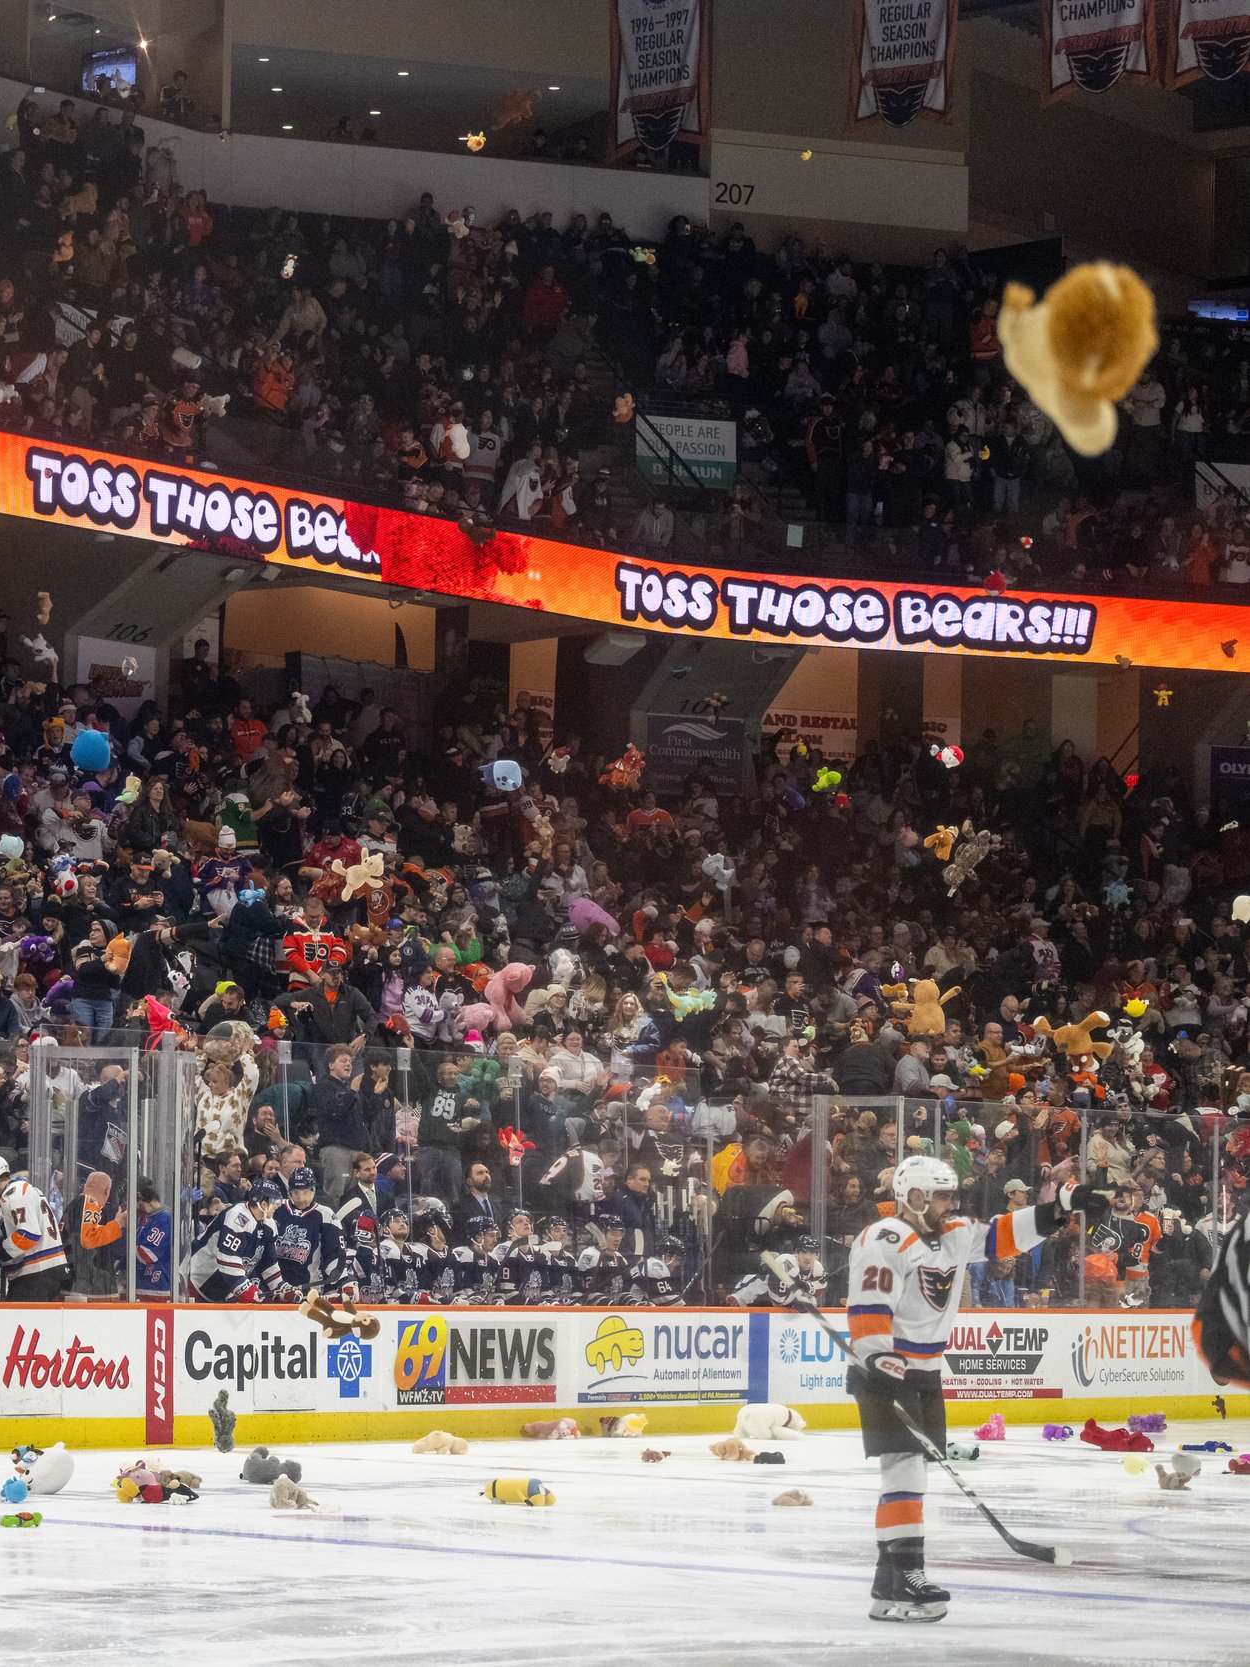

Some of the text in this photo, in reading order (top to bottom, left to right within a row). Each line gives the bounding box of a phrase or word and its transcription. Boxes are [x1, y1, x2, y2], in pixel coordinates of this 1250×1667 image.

[880, 2, 931, 24] REGULAR
[1060, 0, 1136, 22] CHAMPIONS
[635, 29, 684, 53] REGULAR
[882, 22, 926, 42] SEASON
[638, 48, 681, 70] SEASON
[871, 40, 936, 63] CHAMPIONS
[629, 65, 690, 90] CHAMPIONS
[715, 182, 755, 205] 207
[698, 427, 720, 439] ARE
[676, 442, 725, 456] PASSION
[32, 454, 136, 518] TOSS
[620, 569, 713, 621] TOSS
[106, 623, 153, 642] 106
[762, 714, 797, 728] AND
[649, 743, 741, 761] Commonwealth
[667, 736, 692, 747] First
[1219, 762, 1250, 775] OLY
[431, 1096, 456, 1119] 89
[84, 1210, 100, 1225] 25
[147, 1227, 165, 1247] 31
[221, 1232, 242, 1252] 58
[657, 1281, 673, 1294] 64
[861, 1265, 894, 1294] 20
[654, 1324, 744, 1361] nucar
[800, 1330, 849, 1363] LUT
[1002, 1327, 1049, 1352] TEMP
[1100, 1325, 1186, 1359] NETIZEN
[3, 1324, 130, 1390] Hortons
[184, 1330, 317, 1392] Capital
[394, 1315, 555, 1391] 69 NEWS
[153, 1317, 166, 1422] CCM
[653, 1367, 742, 1381] Automall of Allentown
[959, 1358, 1027, 1371] HOME SERVICES
[1099, 1366, 1185, 1384] CyberSecure Solutions
[800, 1374, 843, 1389] Light and
[941, 1377, 1044, 1386] HEATING COOLING HOT WATER
[956, 1390, 1034, 1399] WWW.DUALTEMP.COM
